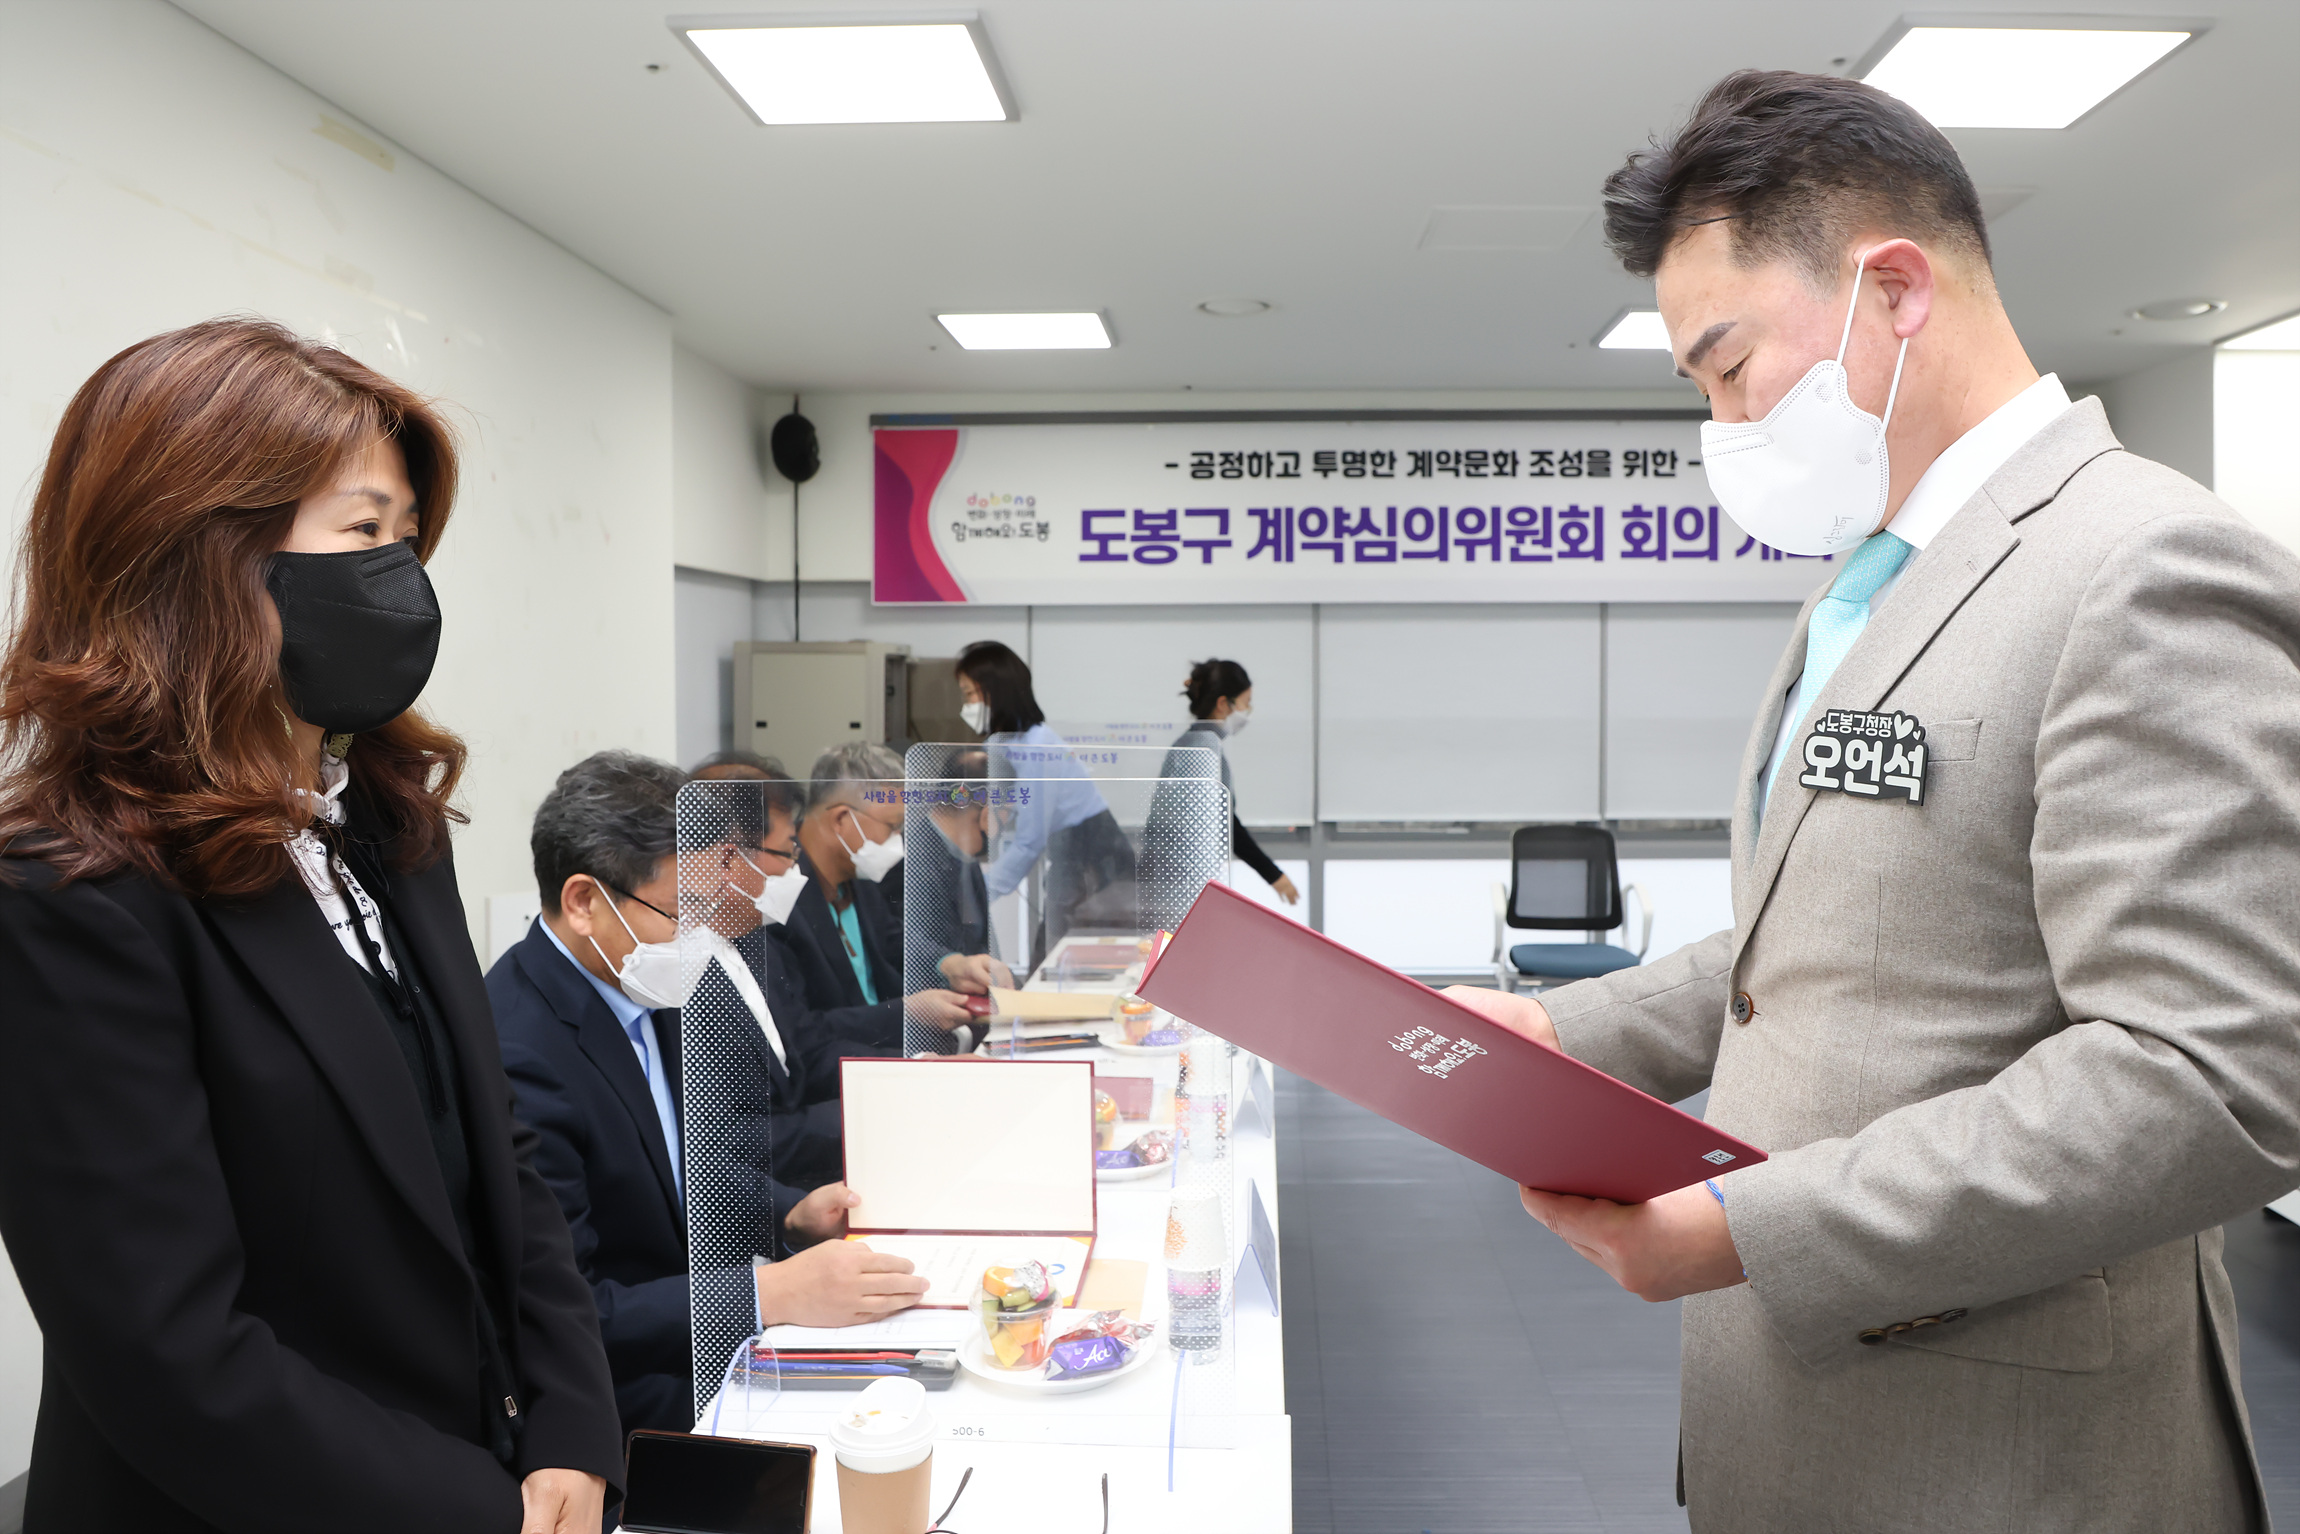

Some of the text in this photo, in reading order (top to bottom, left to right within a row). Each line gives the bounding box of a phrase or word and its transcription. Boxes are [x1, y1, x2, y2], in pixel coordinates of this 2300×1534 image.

[1190, 449, 1302, 480] 공정하고
[1312, 449, 1398, 480] 투명한
[1406, 449, 1521, 479] 계약문화
[1529, 449, 1612, 479] 조성을
[1622, 449, 1679, 478] 위한
[1079, 507, 1233, 565] 도봉구
[1247, 505, 1604, 564] 계약심의위원회
[1620, 505, 1719, 562] 회의
[1826, 712, 1893, 738] 도봉구청장
[1801, 735, 1924, 801] 오언석
[863, 790, 897, 804] 사람을
[1006, 787, 1031, 805] 도봉
[1387, 1026, 1435, 1052] dobong
